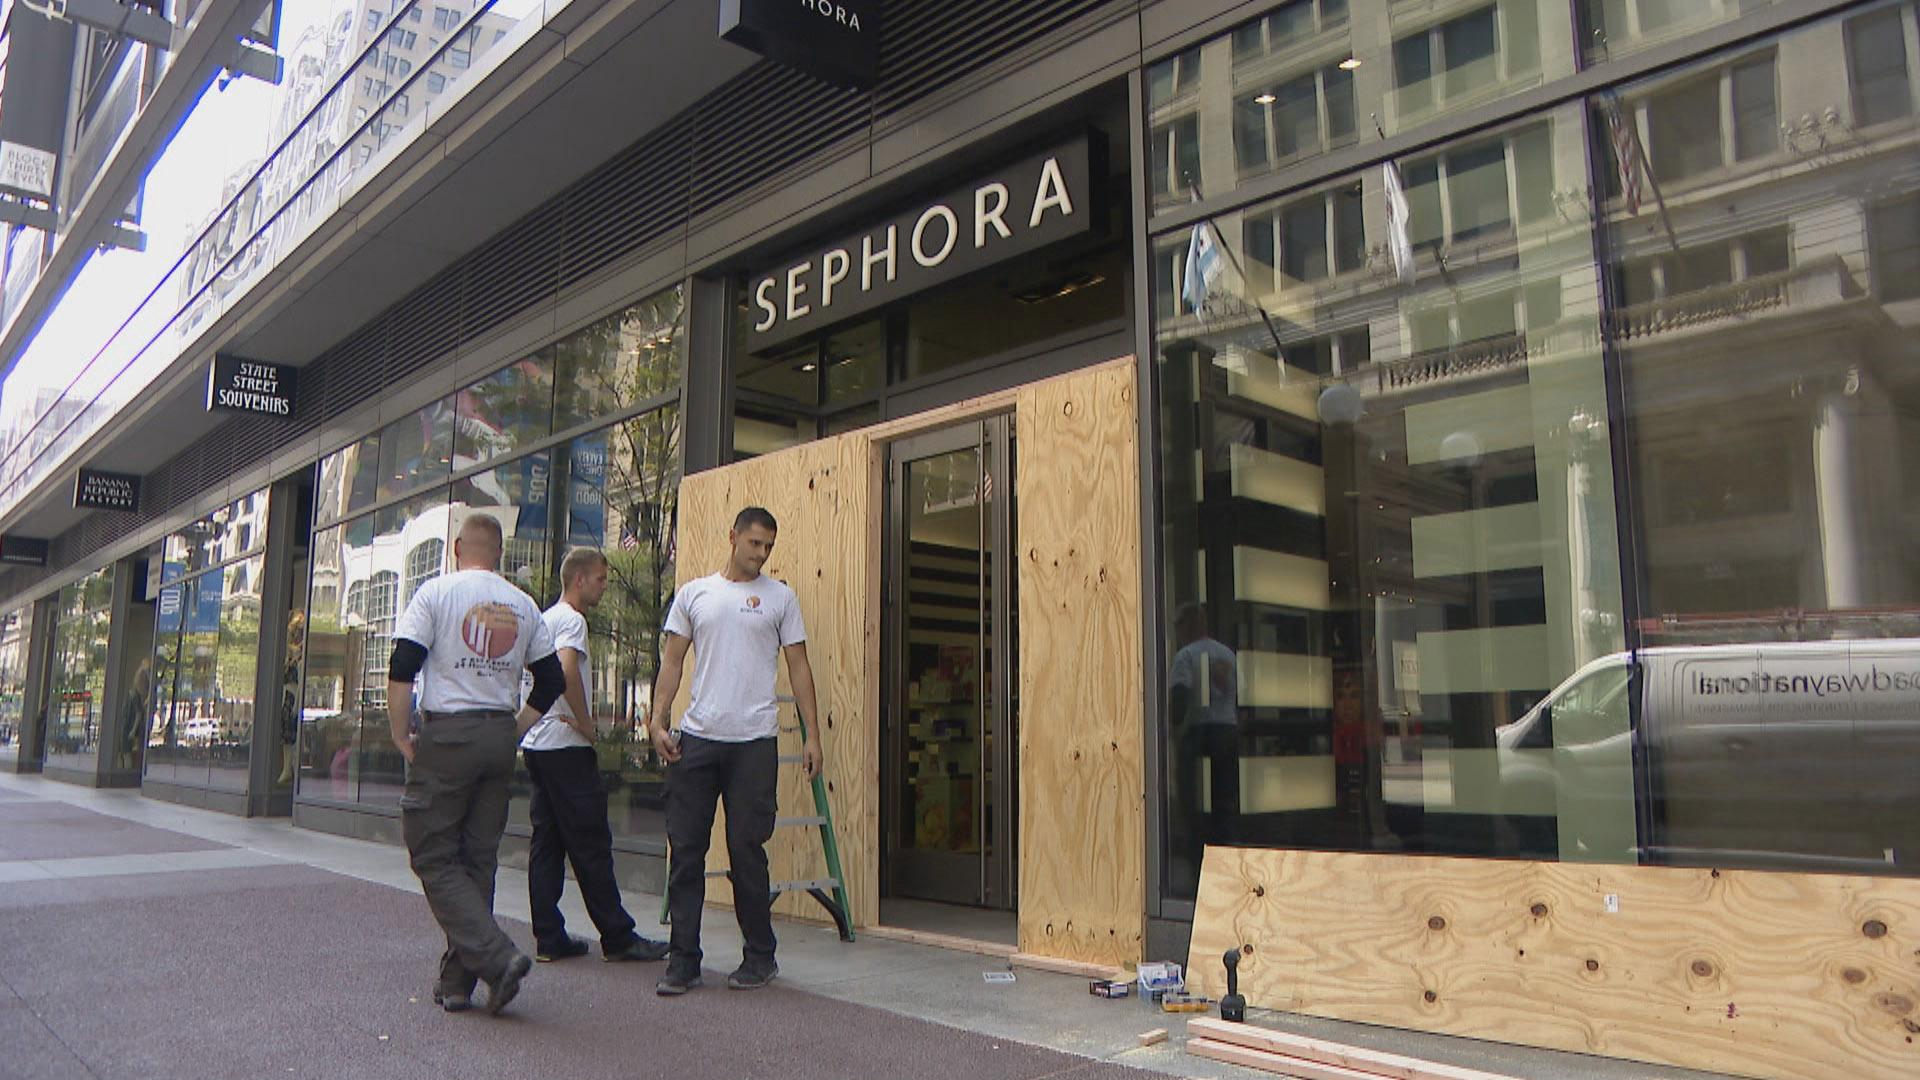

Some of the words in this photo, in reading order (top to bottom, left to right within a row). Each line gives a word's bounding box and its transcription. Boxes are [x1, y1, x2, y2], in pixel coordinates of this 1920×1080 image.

[8, 151, 49, 168] BLOCK
[8, 160, 48, 177] THIRTY
[7, 169, 45, 187] SEVEN
[754, 157, 1074, 333] SEPHORA
[240, 363, 277, 380] STATE
[232, 375, 279, 394] STREET
[218, 389, 289, 415] SOUVENIRS
[88, 475, 130, 488] BANANA
[82, 494, 133, 506] FACTORY
[84, 485, 133, 498] REPUBLIC
